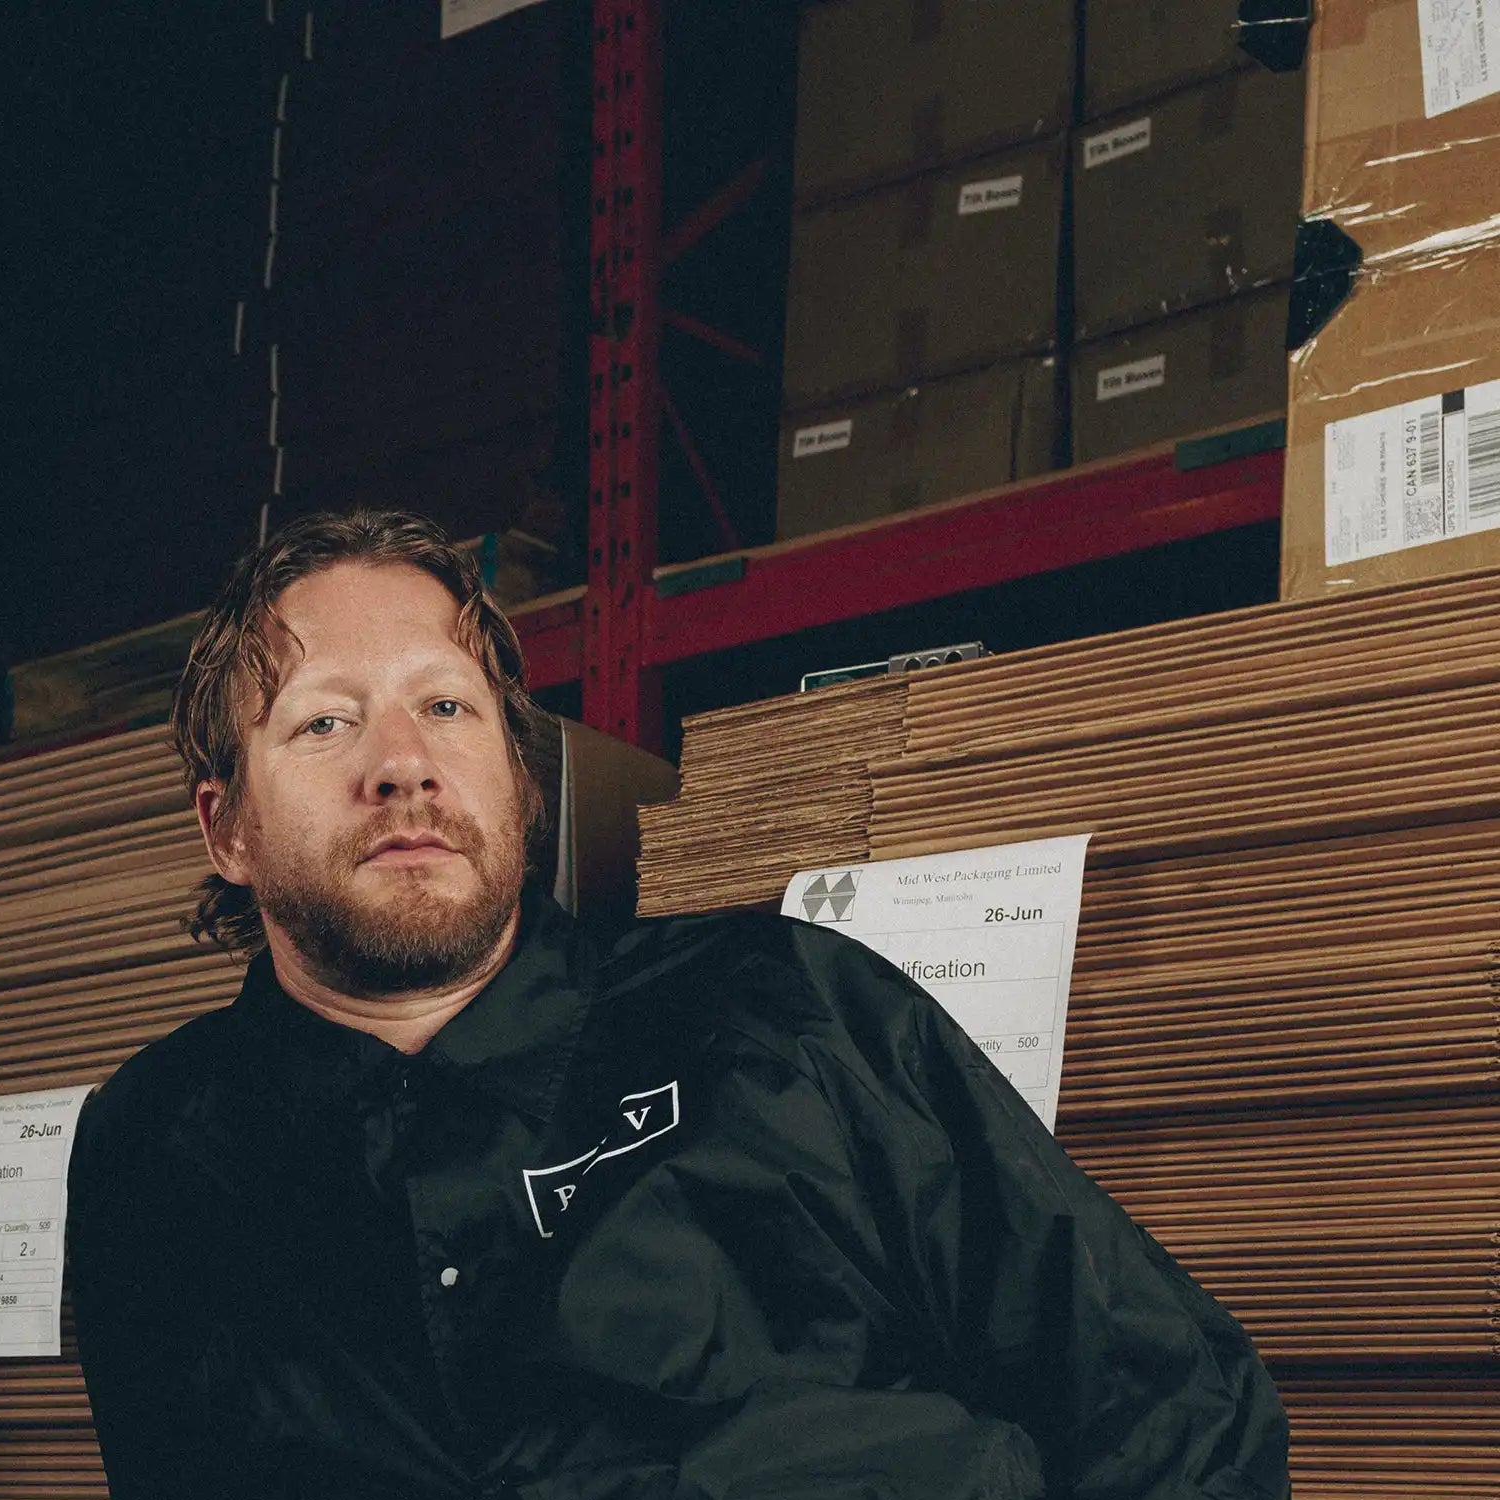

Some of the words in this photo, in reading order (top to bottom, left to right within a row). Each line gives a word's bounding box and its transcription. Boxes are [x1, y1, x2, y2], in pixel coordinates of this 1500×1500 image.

[1406, 419, 1417, 443] 9-01
[1406, 470, 1417, 496] CAN
[897, 874, 919, 886] Mid
[923, 872, 950, 884] West
[953, 868, 1012, 883] Packaging
[1016, 862, 1062, 877] Limited
[984, 907, 1043, 923] 26-Jun
[901, 959, 985, 980] lification
[978, 1040, 1002, 1053] ntity
[1018, 1037, 1039, 1049] 500
[20, 1123, 62, 1138] 26-Jun
[4, 1223, 30, 1234] Quantity
[20, 1242, 28, 1257] 2
